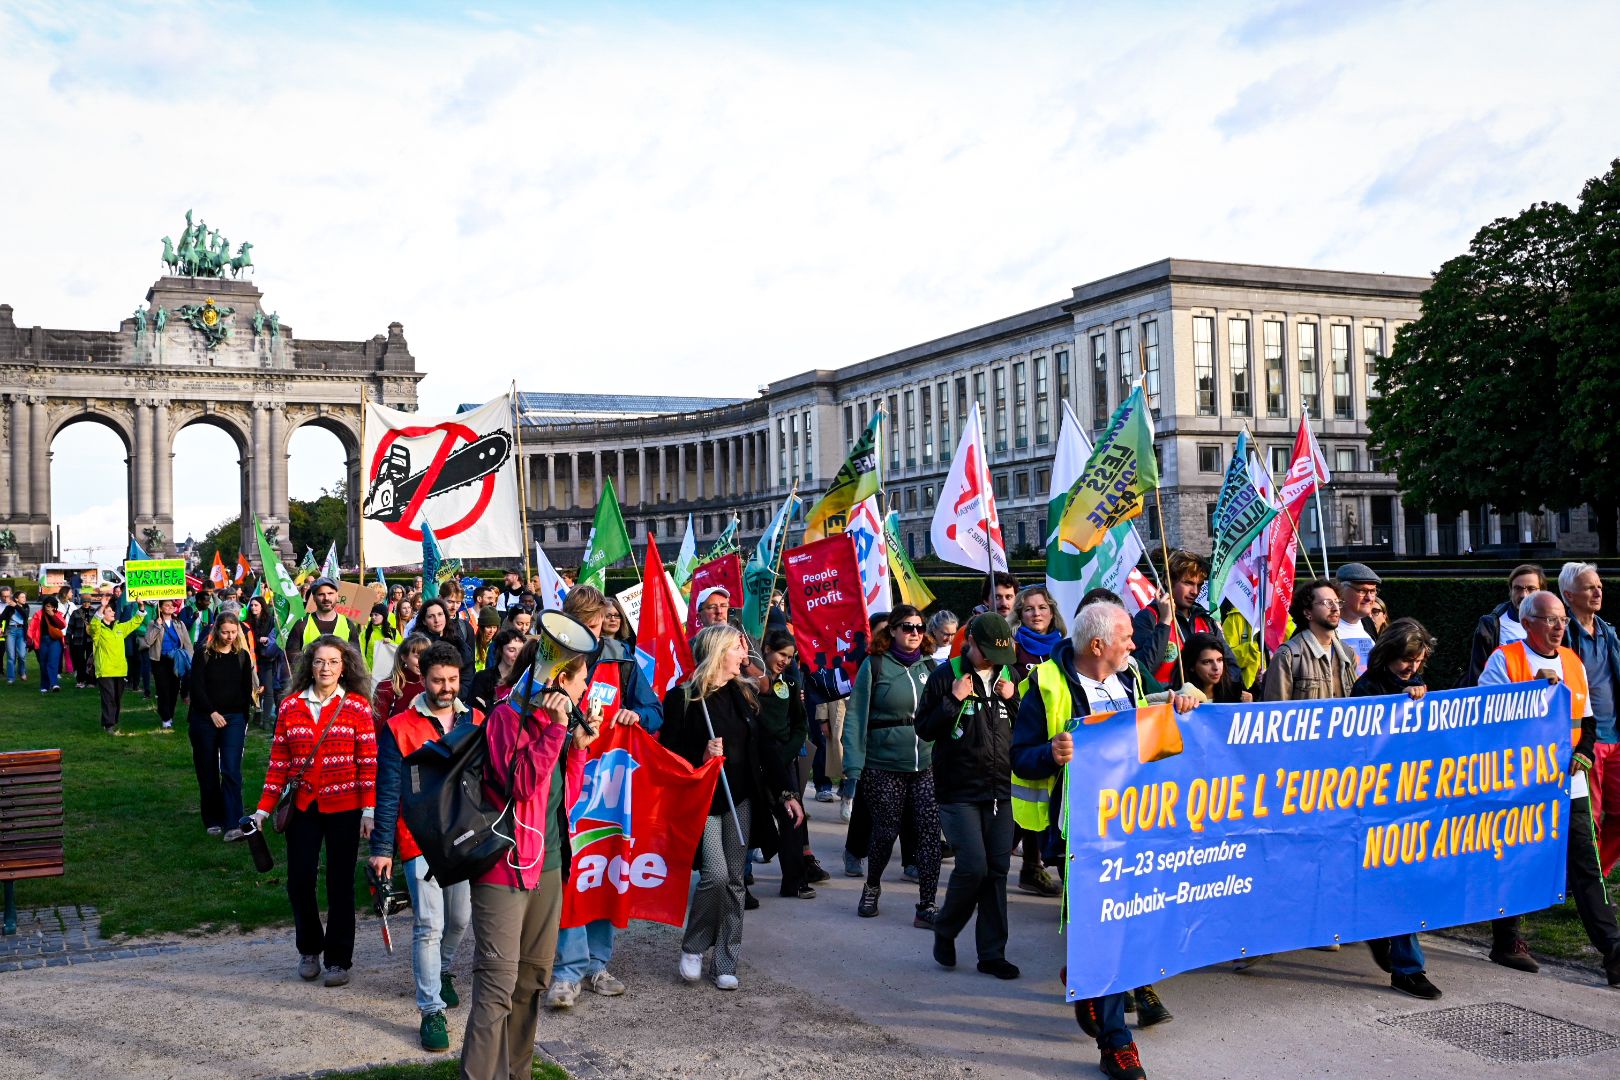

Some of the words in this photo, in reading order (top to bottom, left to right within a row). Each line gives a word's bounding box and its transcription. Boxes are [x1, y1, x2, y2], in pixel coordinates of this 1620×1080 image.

[127, 569, 178, 579] JUSTICE
[802, 568, 838, 584] People
[804, 578, 840, 597] over
[806, 590, 843, 612] profit
[593, 683, 616, 702] FNV
[1226, 707, 1324, 745] MARCHE
[1327, 703, 1385, 739] POUR
[1389, 699, 1424, 735] LES
[1427, 695, 1482, 732] DROITS
[1483, 686, 1550, 725] HUMAINS
[1097, 782, 1180, 837] POUR
[1186, 774, 1246, 832] QUE
[1397, 760, 1433, 803] NE
[1435, 751, 1515, 798] RECULE
[1520, 743, 1565, 789] PAS,
[1362, 820, 1431, 869] NOUS
[1432, 803, 1545, 860] AVANÇONS
[1551, 799, 1559, 839] !
[1156, 840, 1247, 873] septembre
